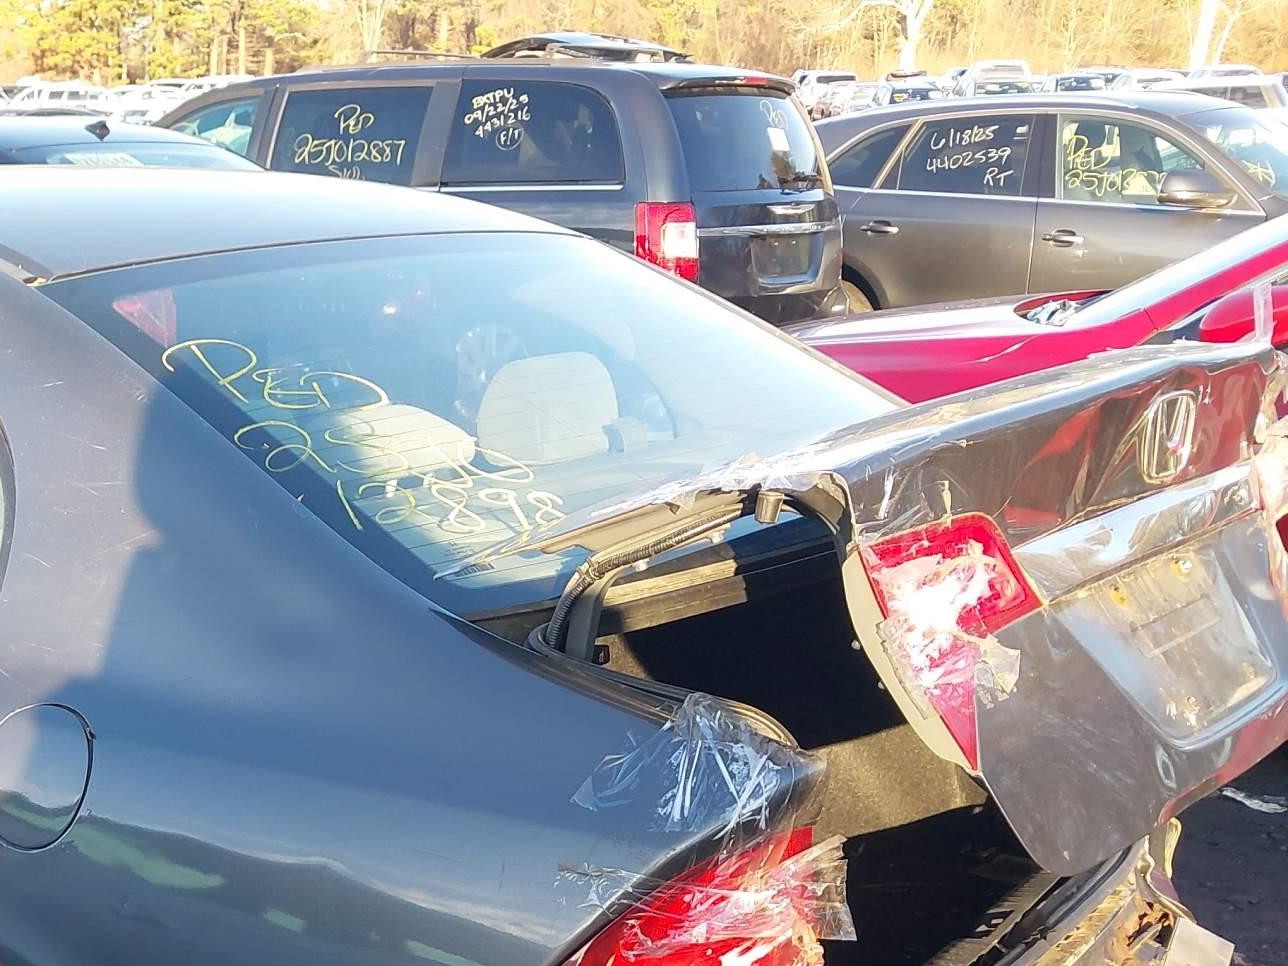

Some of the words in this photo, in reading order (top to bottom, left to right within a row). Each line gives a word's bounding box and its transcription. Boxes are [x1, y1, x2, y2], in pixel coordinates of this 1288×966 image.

[464, 94, 529, 124] 09/22/25
[926, 147, 1012, 174] 4402539
[983, 167, 1015, 187] RT
[162, 338, 391, 410] PED
